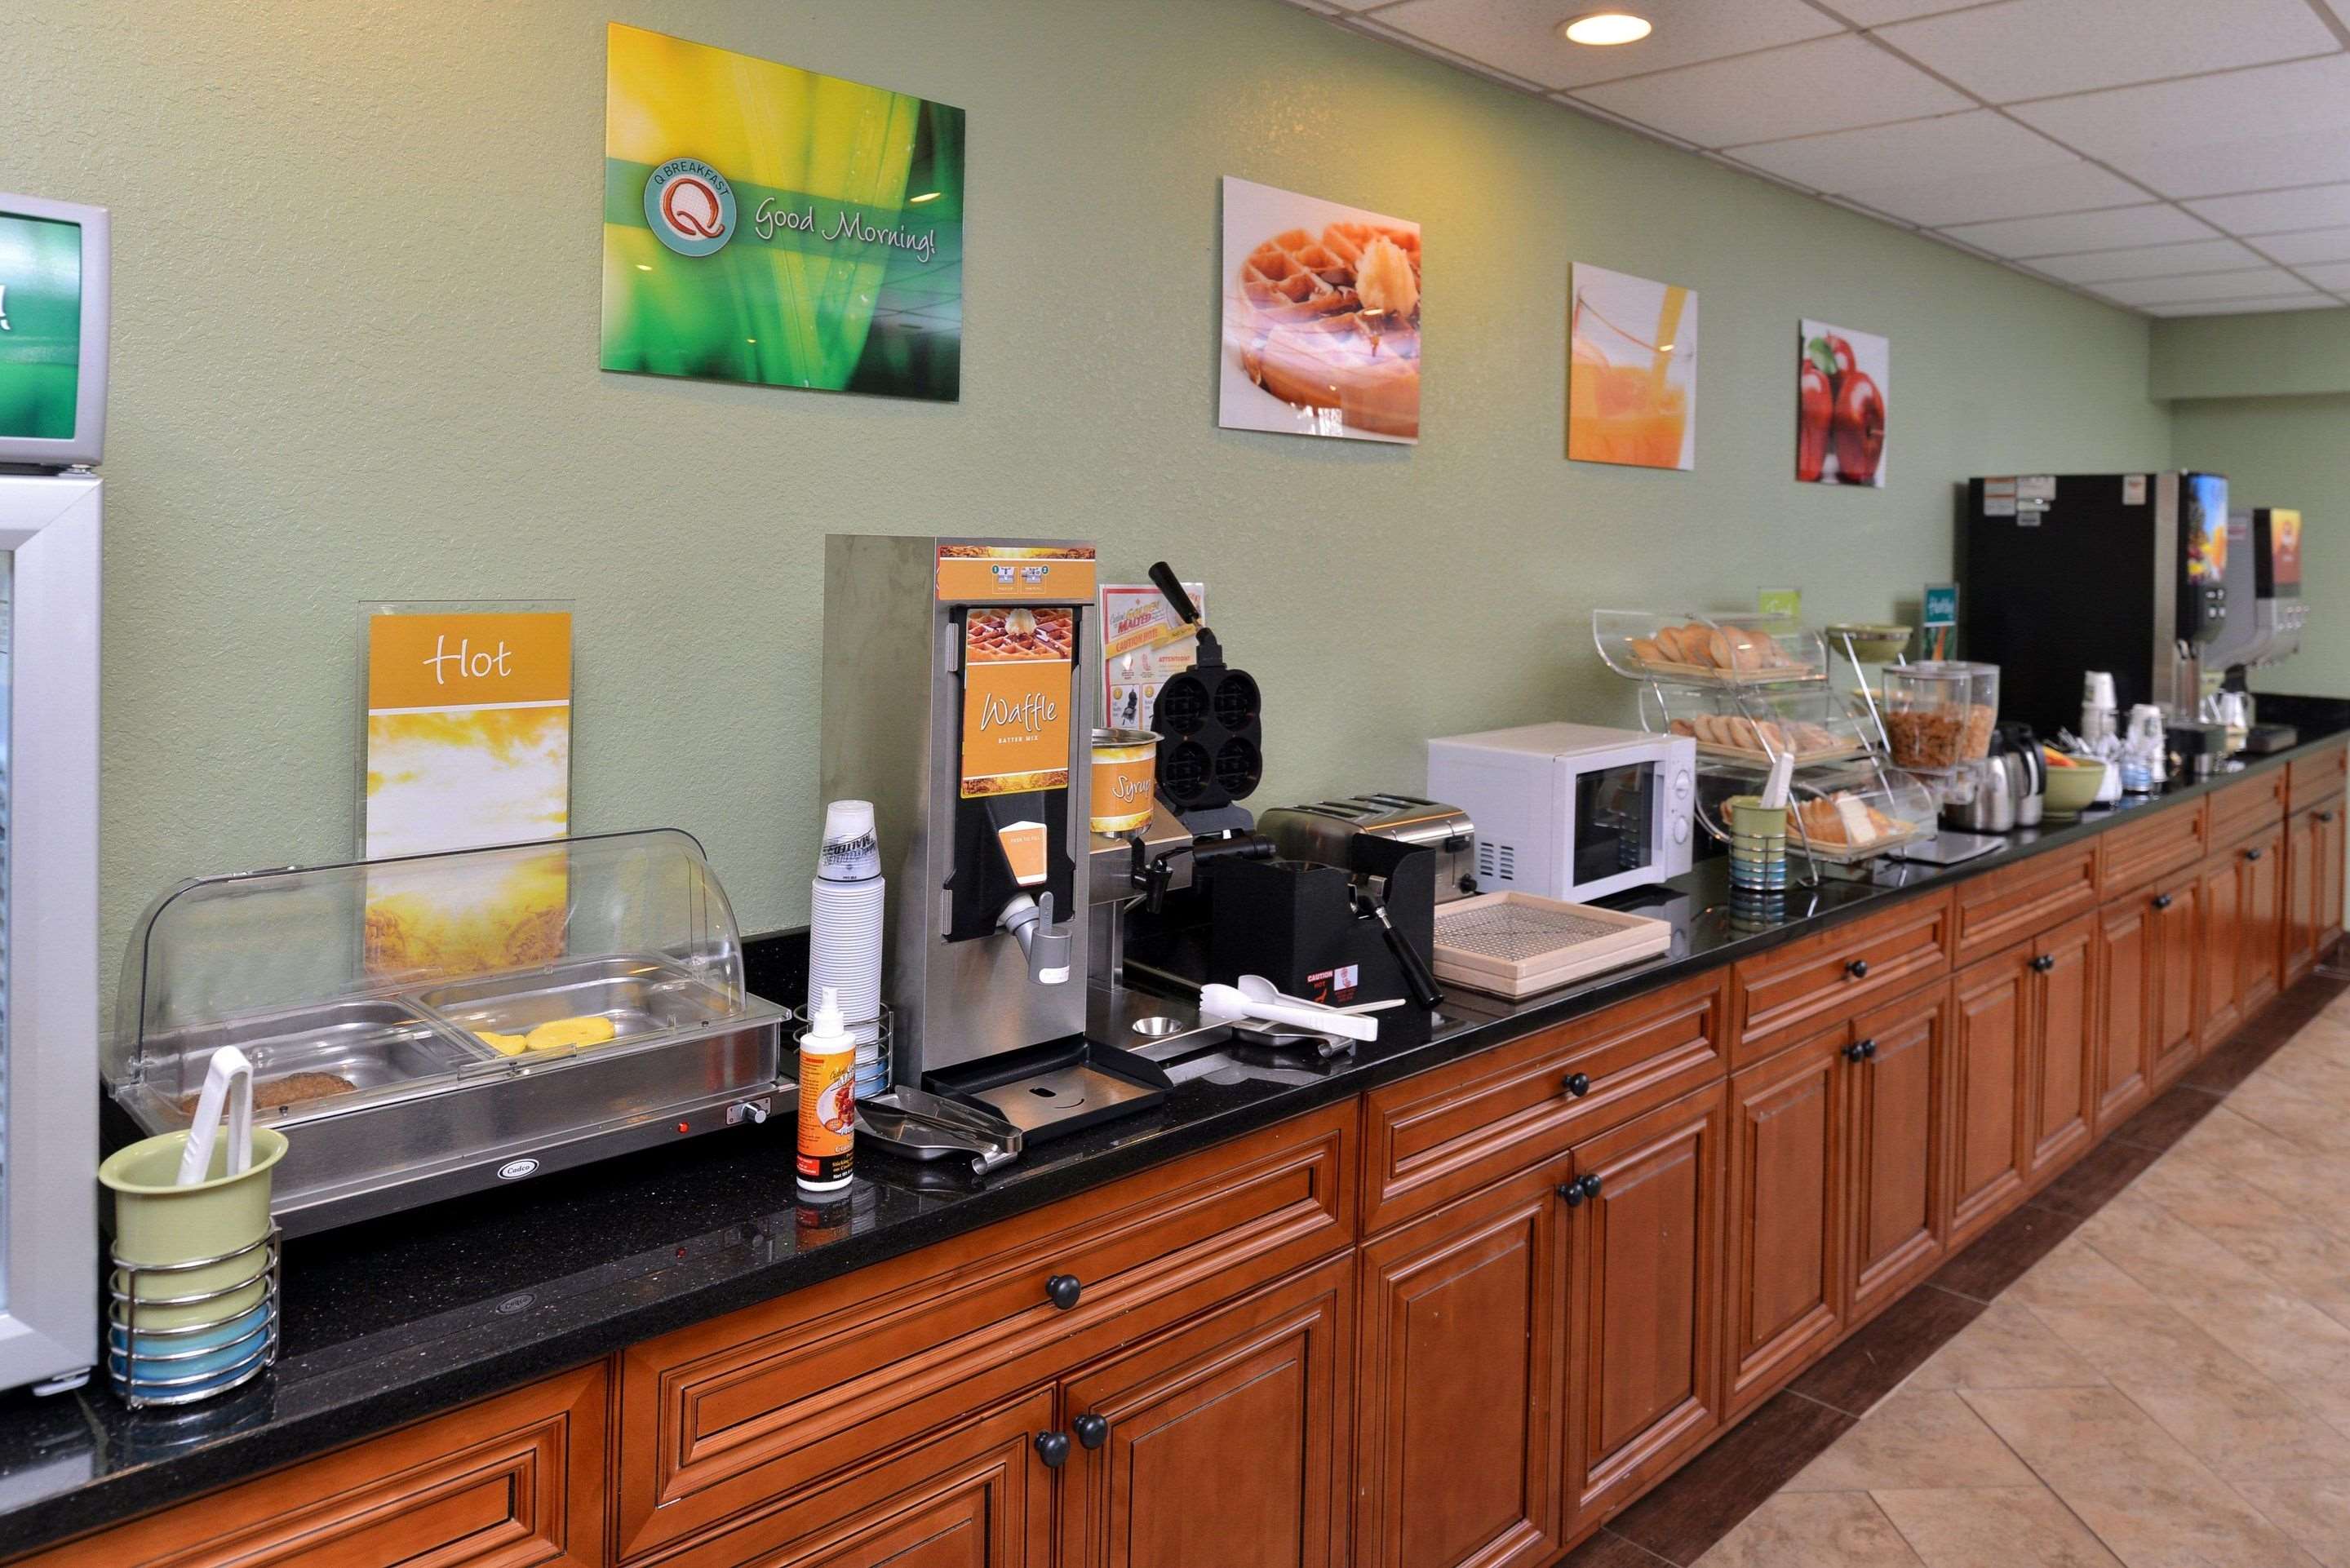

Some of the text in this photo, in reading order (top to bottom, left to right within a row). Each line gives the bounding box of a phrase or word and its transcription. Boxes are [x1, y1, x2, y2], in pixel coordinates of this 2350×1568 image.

[654, 162, 730, 195] Q BREAKFAST
[663, 179, 725, 238] Q
[755, 197, 935, 263] Good Morning!
[1117, 613, 1152, 634] MALTED
[422, 635, 512, 685] Hot
[979, 692, 1058, 732] Waffle
[998, 736, 1022, 744] BATTER
[1111, 775, 1151, 803] Syrup
[1307, 970, 1333, 982] CAUTION
[507, 1165, 530, 1174] Cadco
